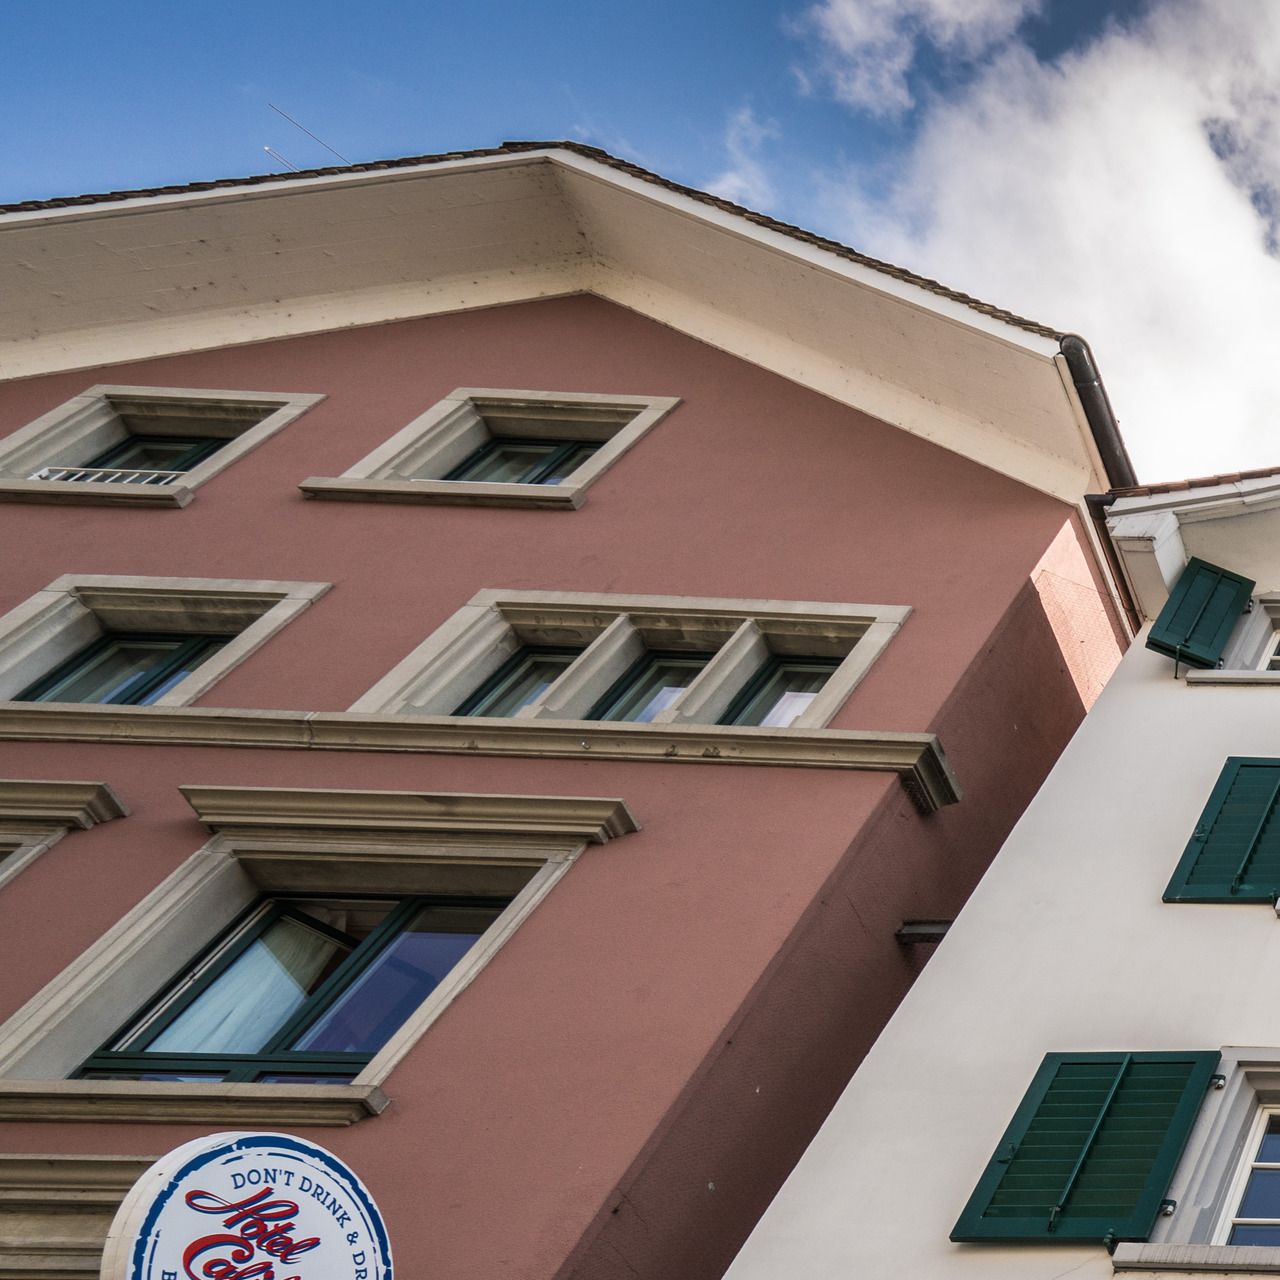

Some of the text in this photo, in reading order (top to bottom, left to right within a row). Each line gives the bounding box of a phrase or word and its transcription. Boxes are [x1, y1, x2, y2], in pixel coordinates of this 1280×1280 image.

[184, 1186, 321, 1264] Hotel
[230, 1168, 295, 1190] DON'T
[298, 1176, 352, 1229] DRINK
[346, 1231, 359, 1246] &
